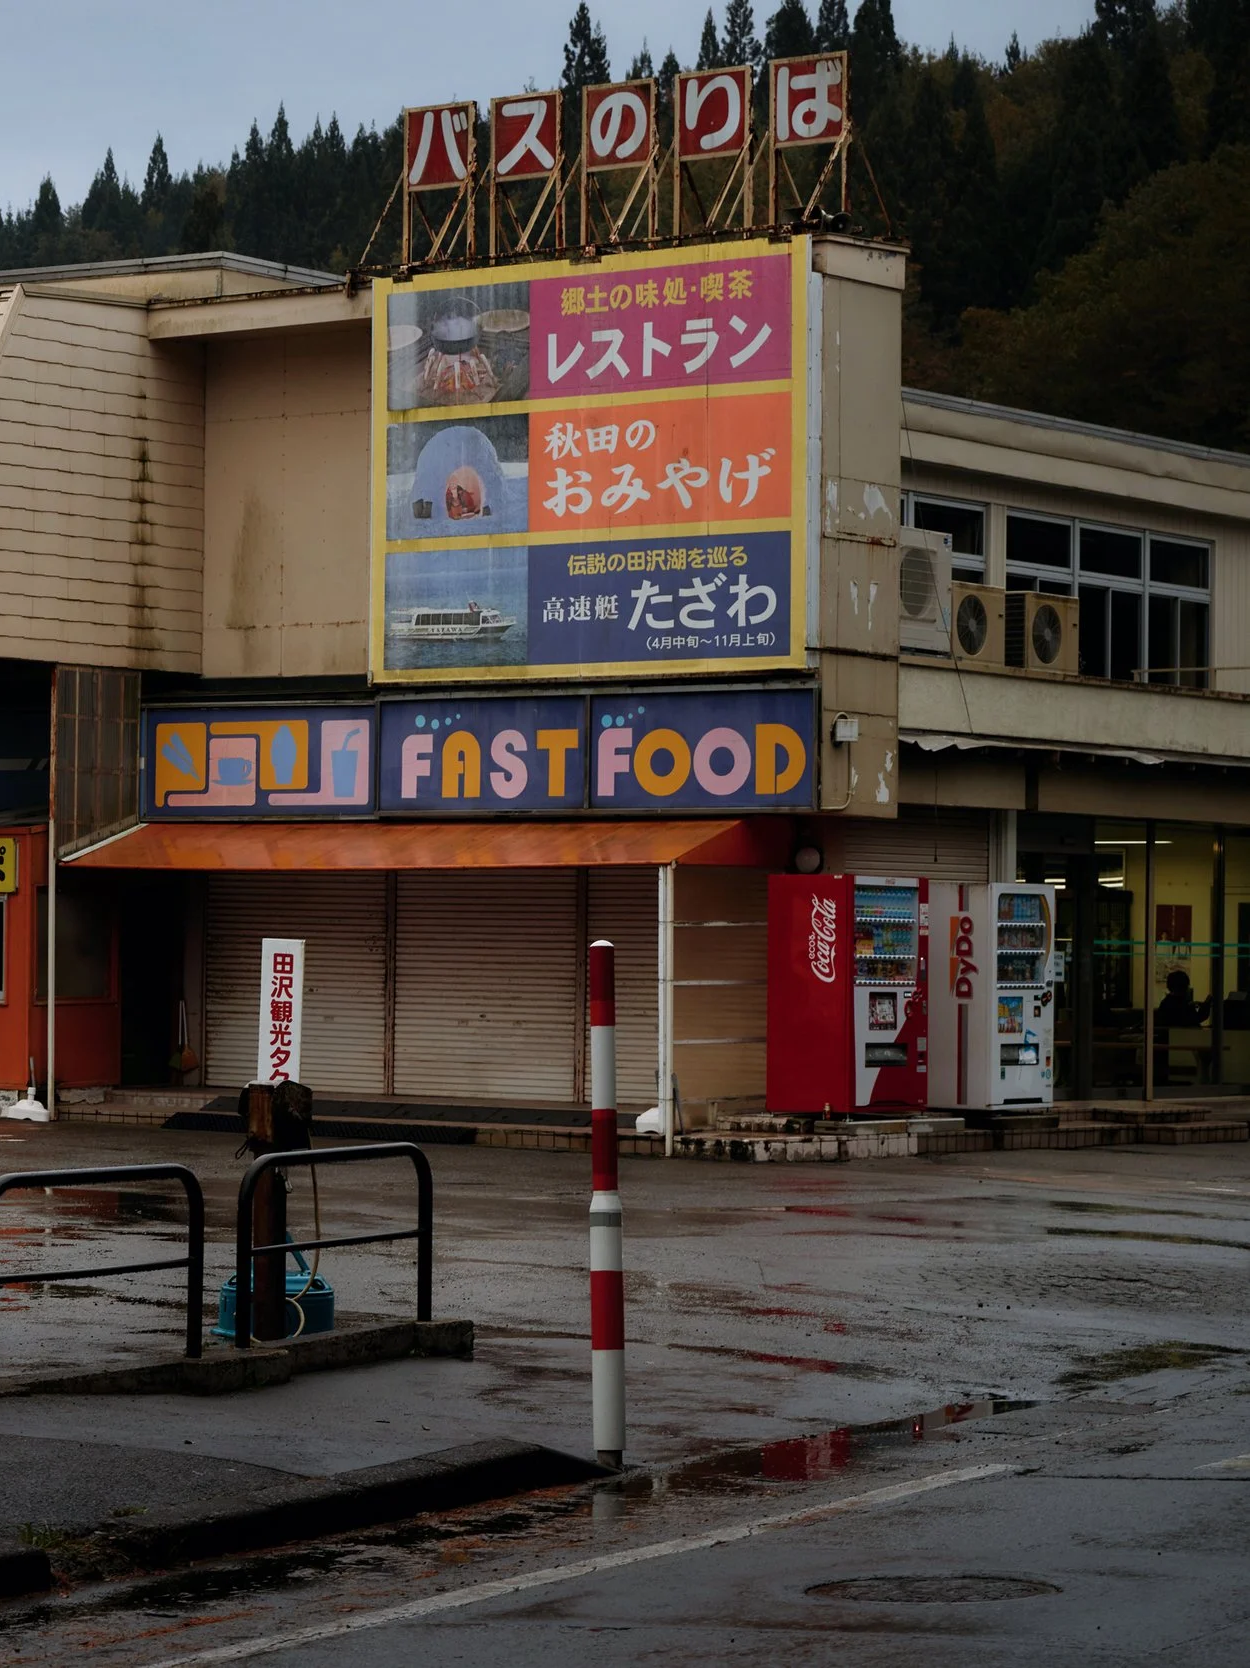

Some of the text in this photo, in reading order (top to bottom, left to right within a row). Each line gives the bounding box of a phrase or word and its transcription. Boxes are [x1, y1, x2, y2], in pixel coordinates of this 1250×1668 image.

[409, 59, 842, 185] バスのりば
[561, 270, 753, 316] 郷土の味処・喫茶
[546, 314, 772, 384] レストラン
[544, 419, 656, 460] 秋田の
[543, 447, 776, 518] おみやげ
[567, 546, 748, 577] 伝説の田沢湖を巡る
[542, 572, 777, 632] 高速艇 たざわ
[401, 723, 806, 799] FAST FOOD
[810, 892, 837, 984] Coca-Cola
[955, 915, 979, 999] DyDo
